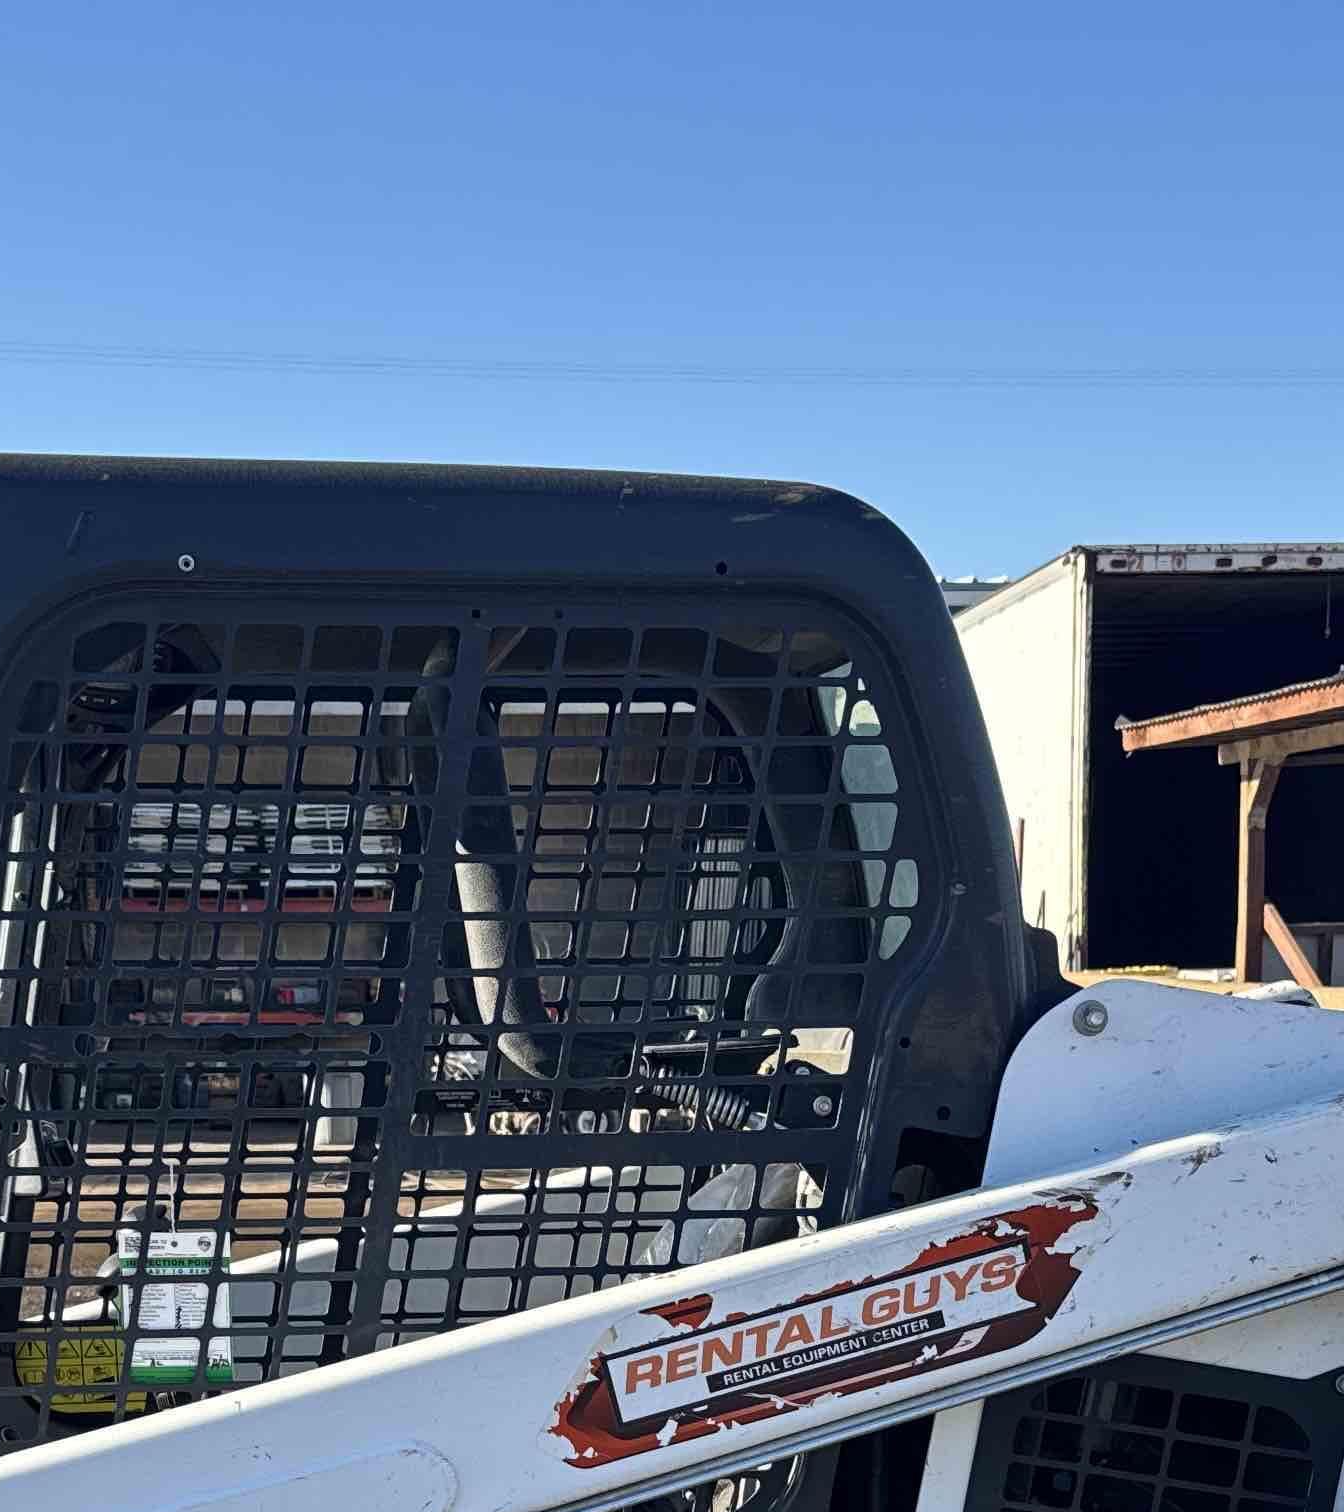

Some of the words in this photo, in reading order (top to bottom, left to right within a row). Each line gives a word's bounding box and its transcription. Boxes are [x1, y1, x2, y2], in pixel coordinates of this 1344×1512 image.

[624, 1305, 851, 1395] RENTAL
[861, 1254, 1018, 1328] GUYS
[723, 1361, 781, 1386] RENTAL
[782, 1335, 869, 1371] EQUIPMENT
[871, 1316, 930, 1345] CENTER
